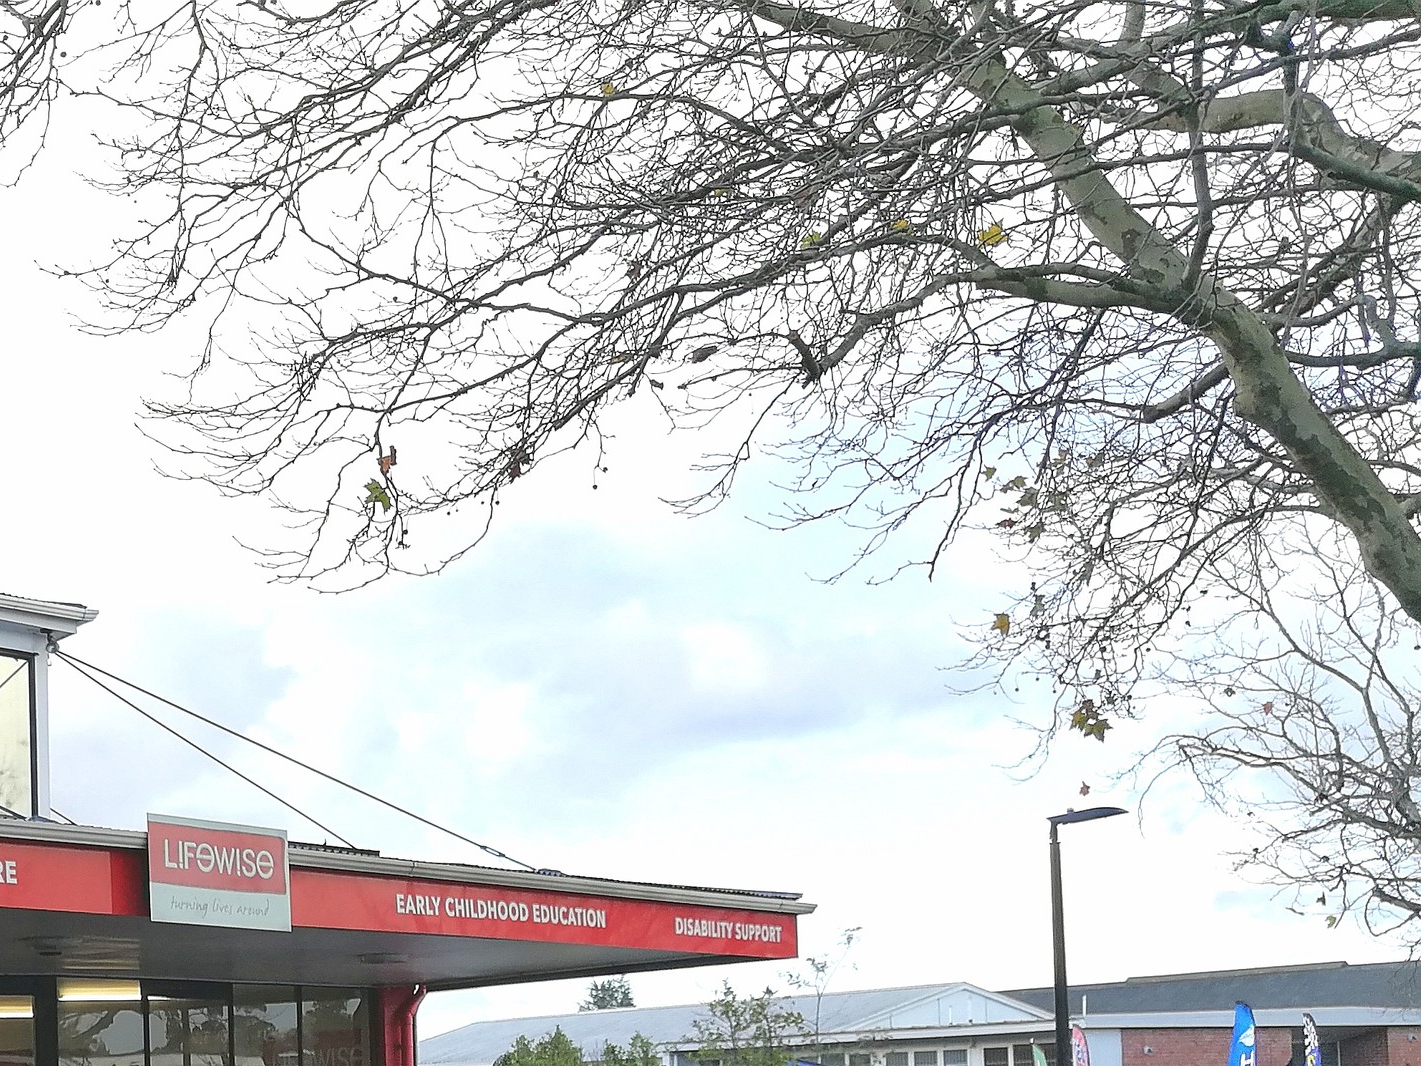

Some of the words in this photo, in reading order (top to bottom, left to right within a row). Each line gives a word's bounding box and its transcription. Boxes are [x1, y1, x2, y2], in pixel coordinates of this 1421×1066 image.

[170, 896, 209, 918] turning
[212, 899, 233, 916] lives
[236, 898, 271, 917] around
[396, 893, 441, 918] EARLY
[444, 897, 529, 924] CHILDHOOD
[532, 902, 607, 929] EDUCATION
[675, 916, 733, 940] DISABILITY
[734, 920, 782, 943] SUPPORT
